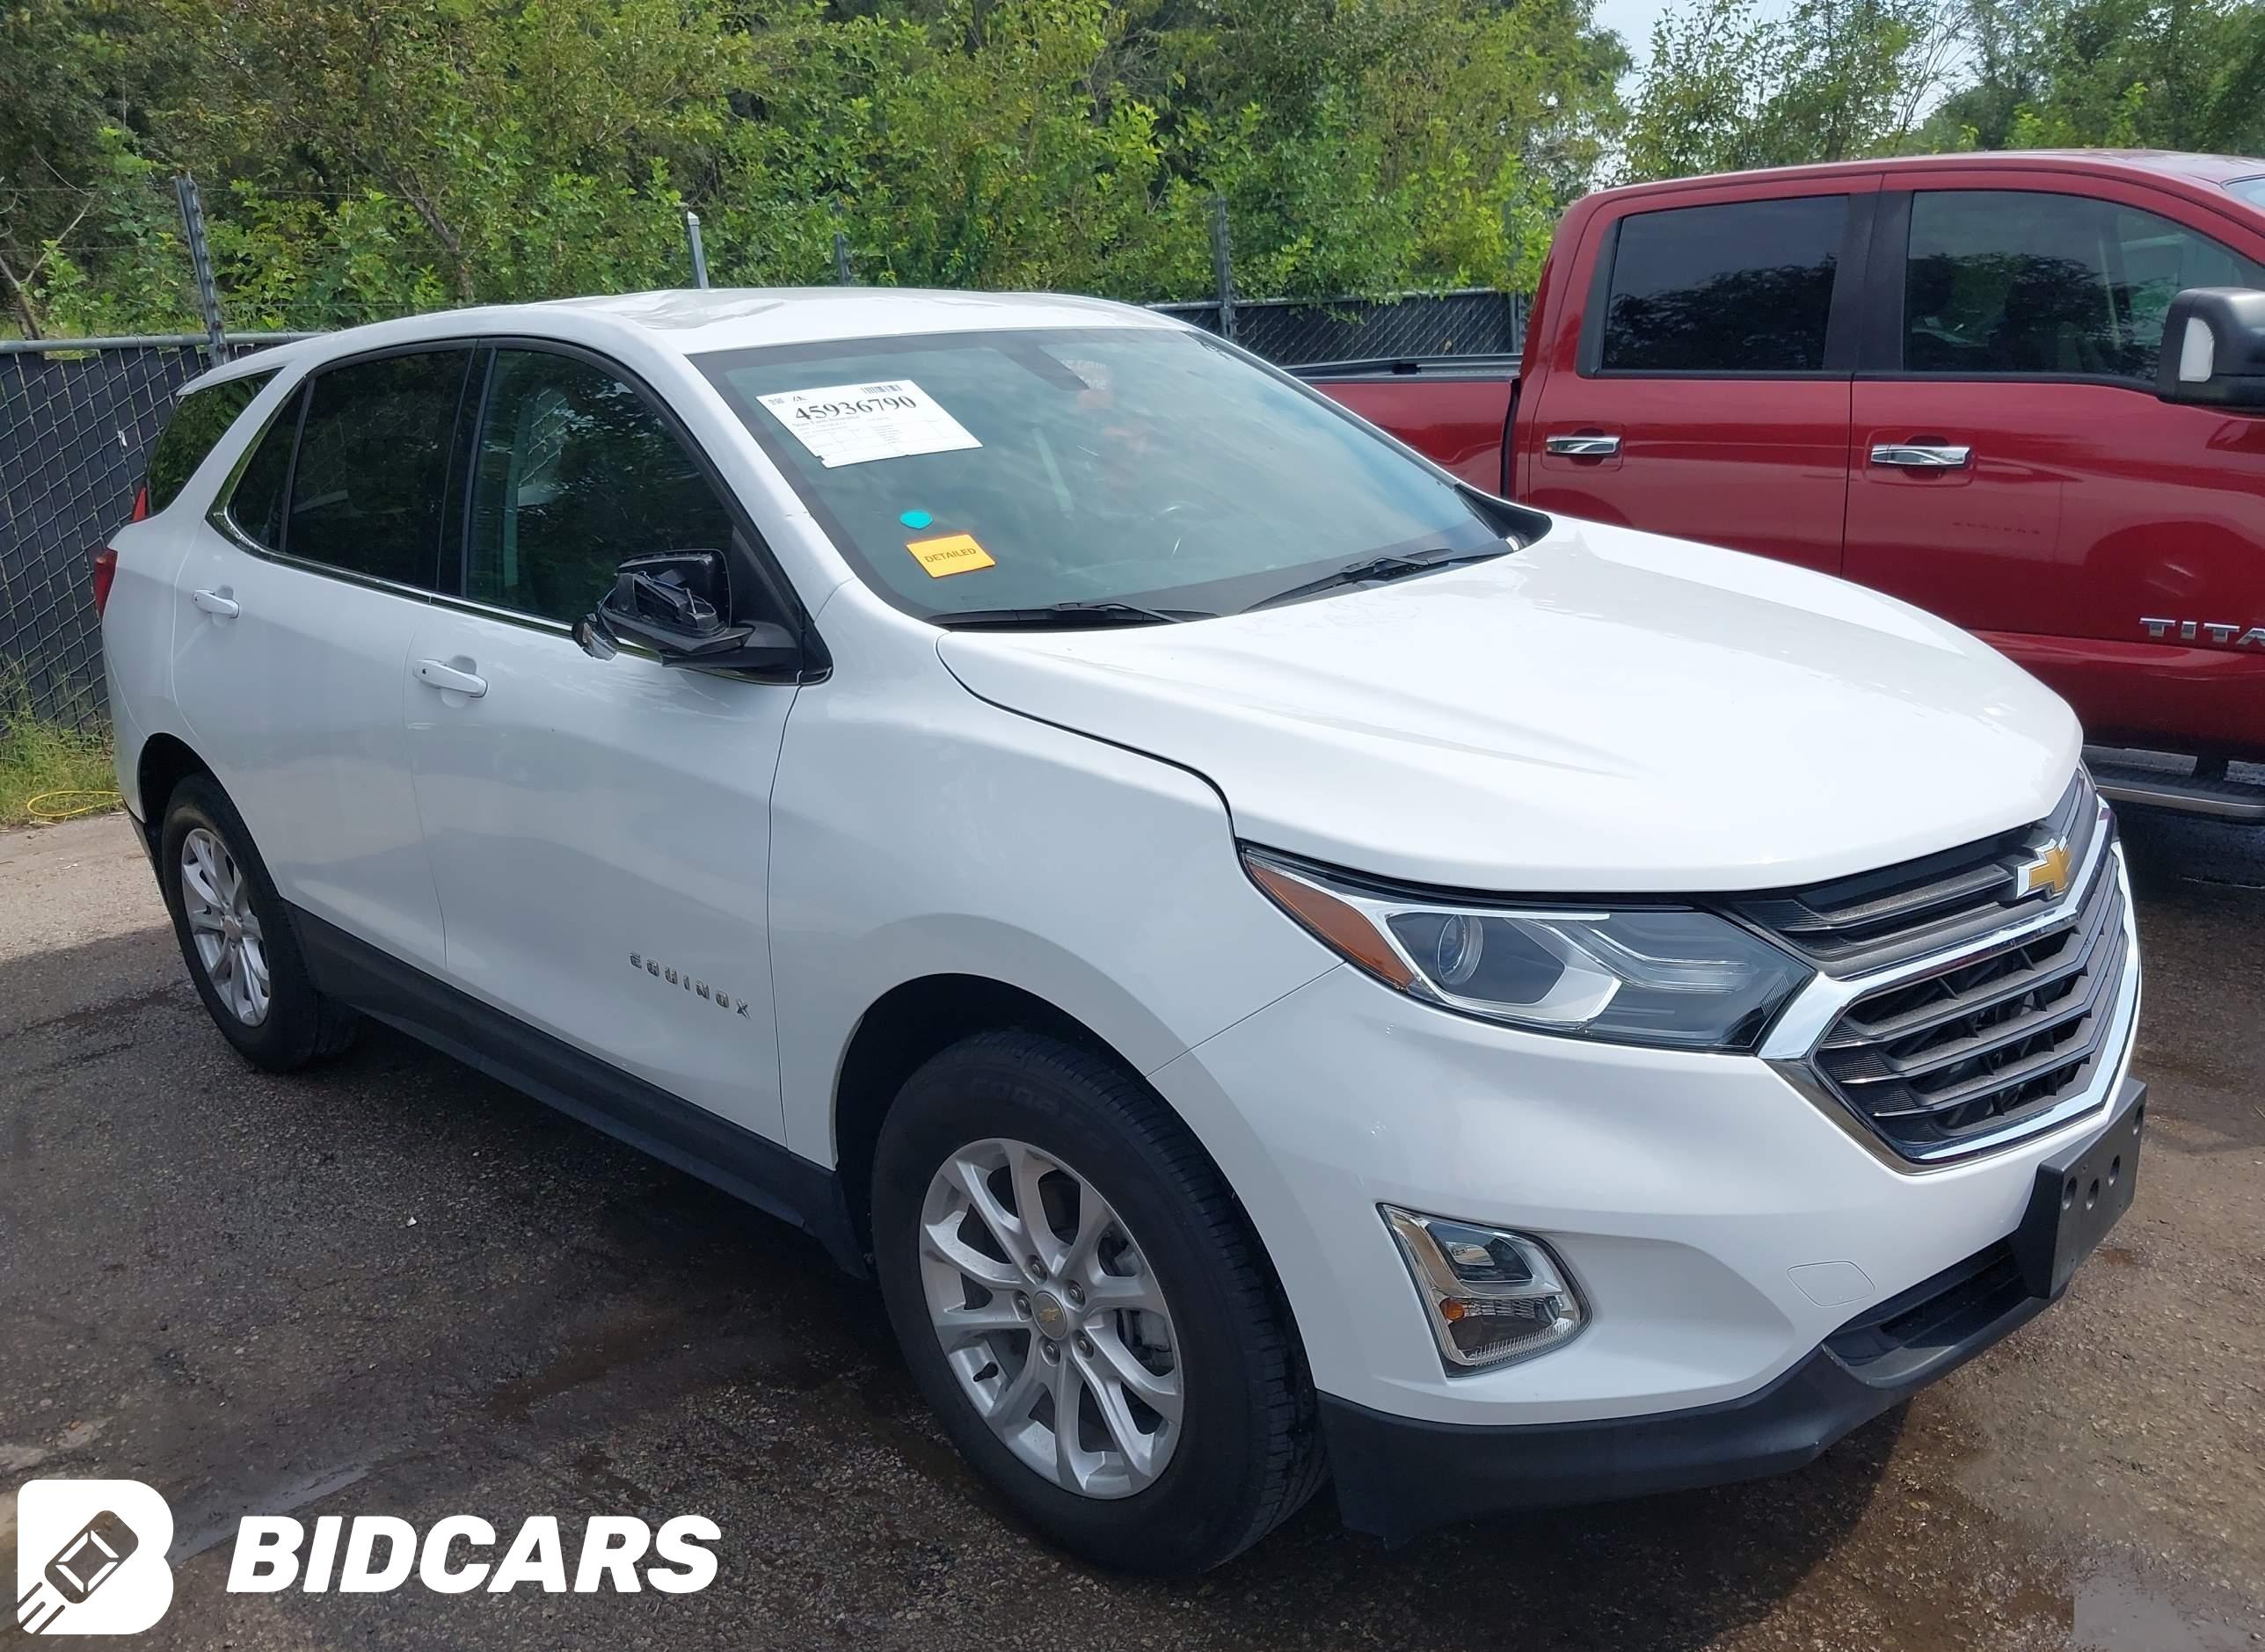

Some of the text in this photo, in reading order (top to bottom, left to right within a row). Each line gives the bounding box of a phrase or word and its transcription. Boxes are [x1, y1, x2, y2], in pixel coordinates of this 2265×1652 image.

[795, 396, 916, 420] 45936790
[924, 548, 977, 563] DETAILED
[630, 952, 751, 1019] EQUINOX
